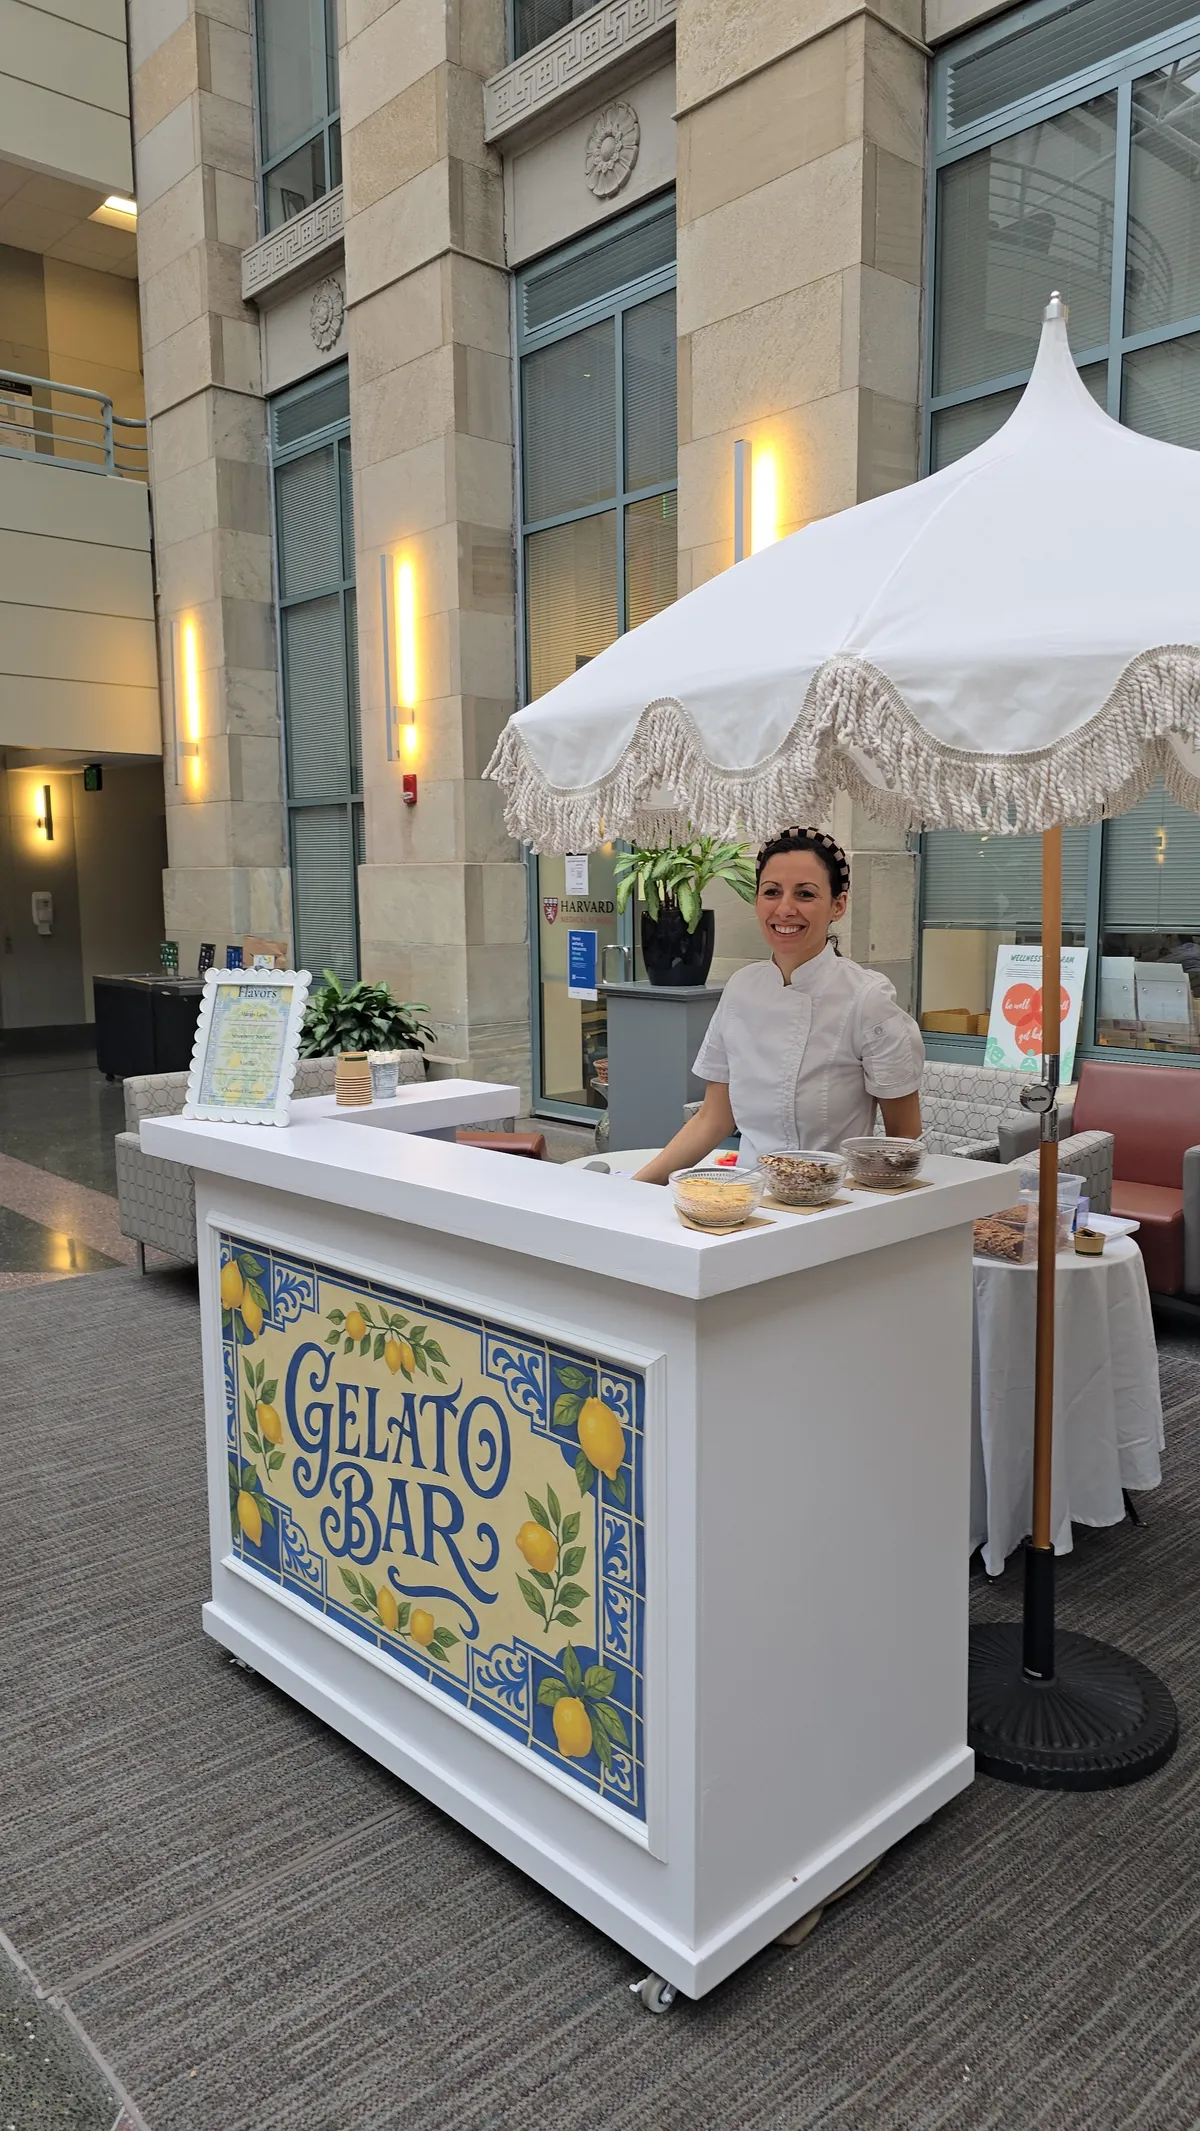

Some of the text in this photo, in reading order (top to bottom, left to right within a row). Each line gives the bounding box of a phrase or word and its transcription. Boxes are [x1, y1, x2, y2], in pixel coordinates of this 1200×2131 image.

[560, 900, 614, 914] HARVARD
[1011, 954, 1042, 963] WELLNESS
[238, 985, 277, 999] Flavors
[1031, 1027, 1042, 1042] hel
[284, 1342, 513, 1500] GELATO
[319, 1461, 500, 1604] BAR
